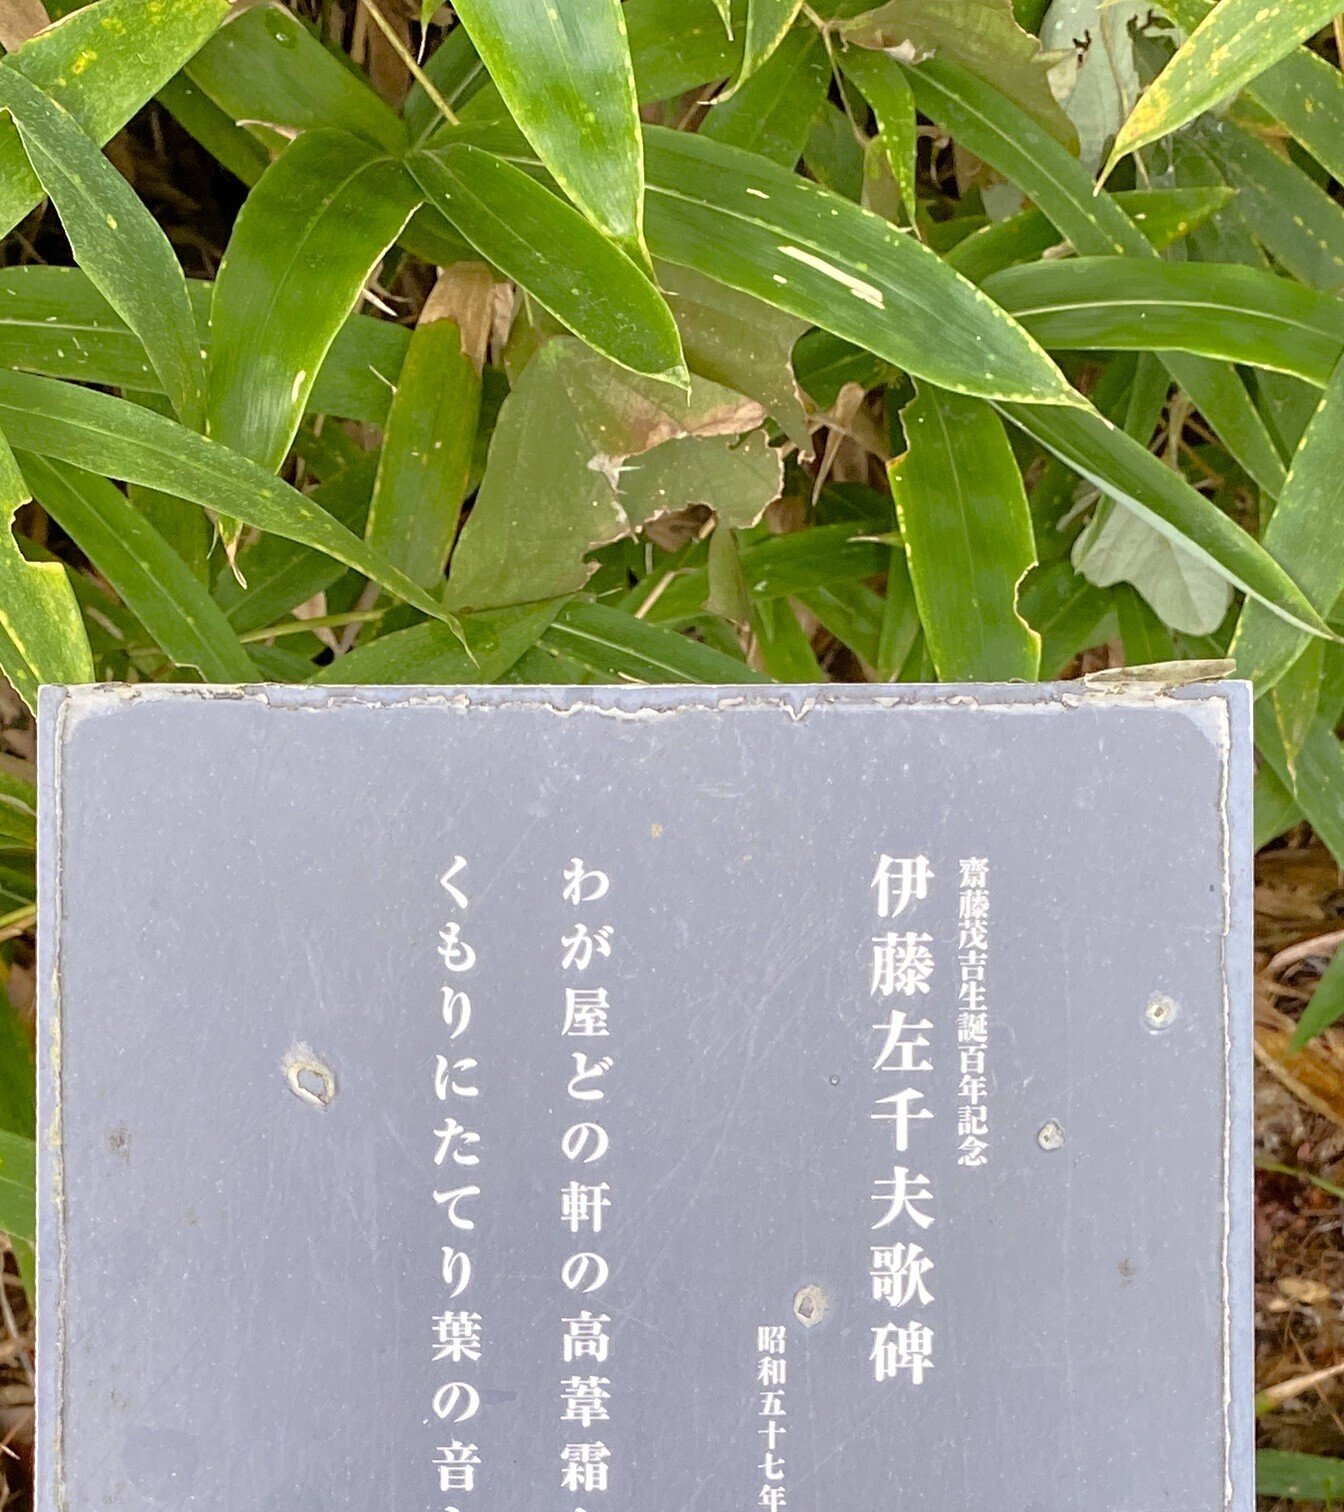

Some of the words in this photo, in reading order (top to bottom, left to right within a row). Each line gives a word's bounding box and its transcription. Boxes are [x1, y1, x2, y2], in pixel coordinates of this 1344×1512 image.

[869, 853, 936, 1386] 伊藤左千夫歌碑
